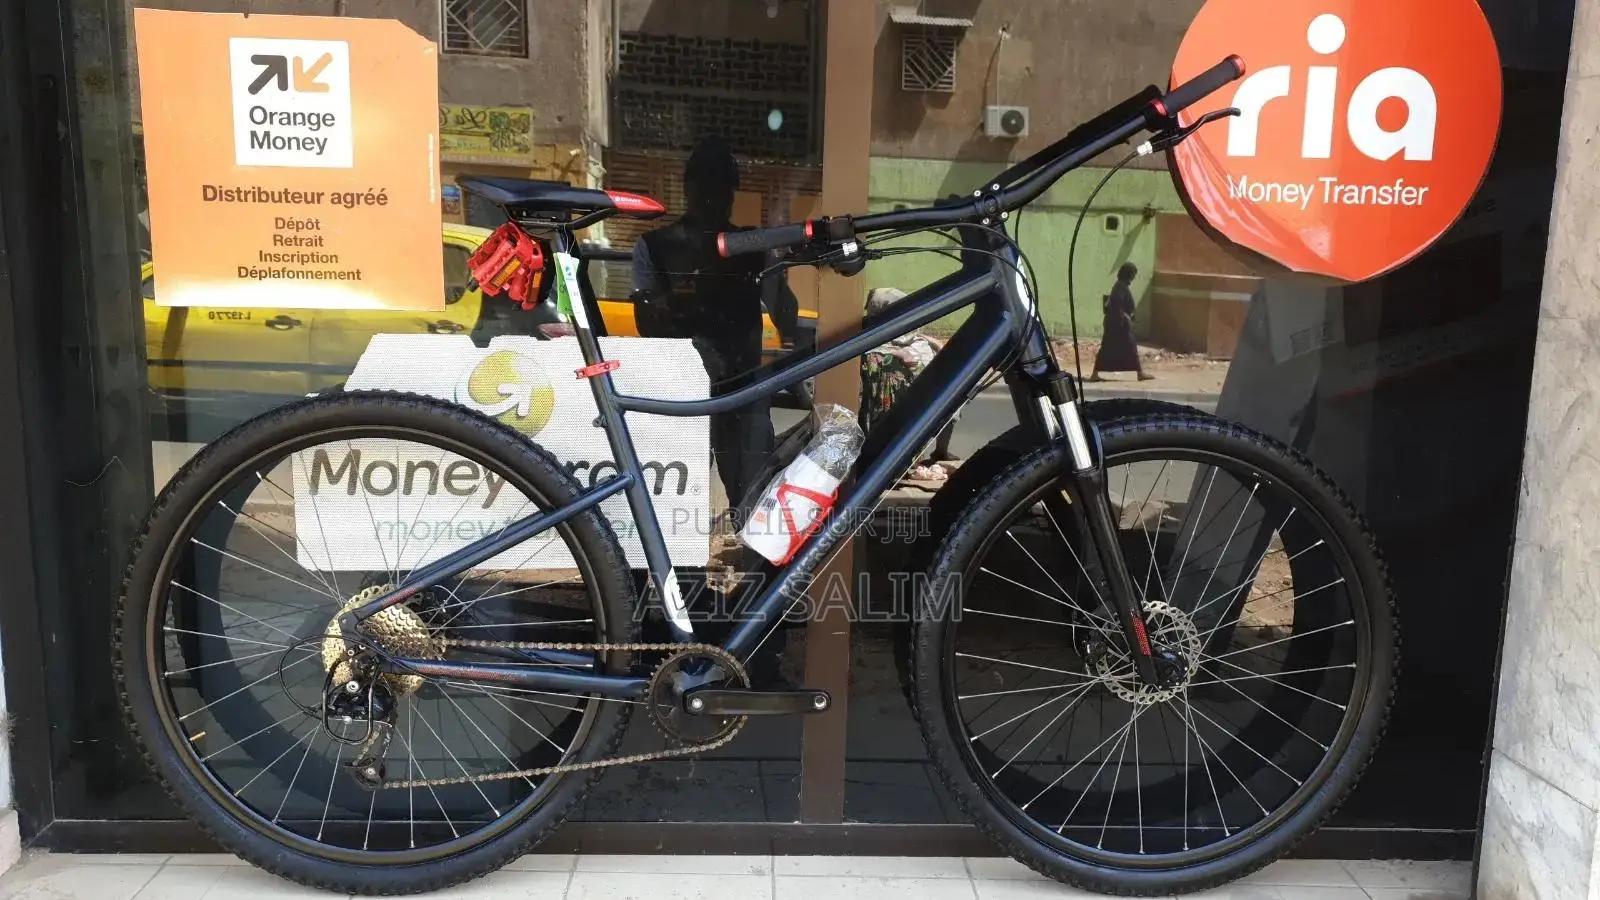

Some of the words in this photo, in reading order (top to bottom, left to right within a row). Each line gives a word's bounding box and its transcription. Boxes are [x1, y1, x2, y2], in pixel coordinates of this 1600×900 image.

[1227, 13, 1437, 161] ria
[249, 105, 336, 132] Orange
[250, 130, 328, 155] Money
[202, 184, 325, 205] Distributeur
[330, 188, 389, 209] agréé
[1226, 174, 1315, 210] Money
[1318, 176, 1429, 206] Transfer
[274, 216, 321, 233] Dépôt
[272, 234, 324, 247] Retrait
[258, 250, 339, 266] Inscription
[237, 266, 362, 281] Déplafonnement
[309, 449, 689, 509] Moneyram
[374, 518, 497, 542] money
